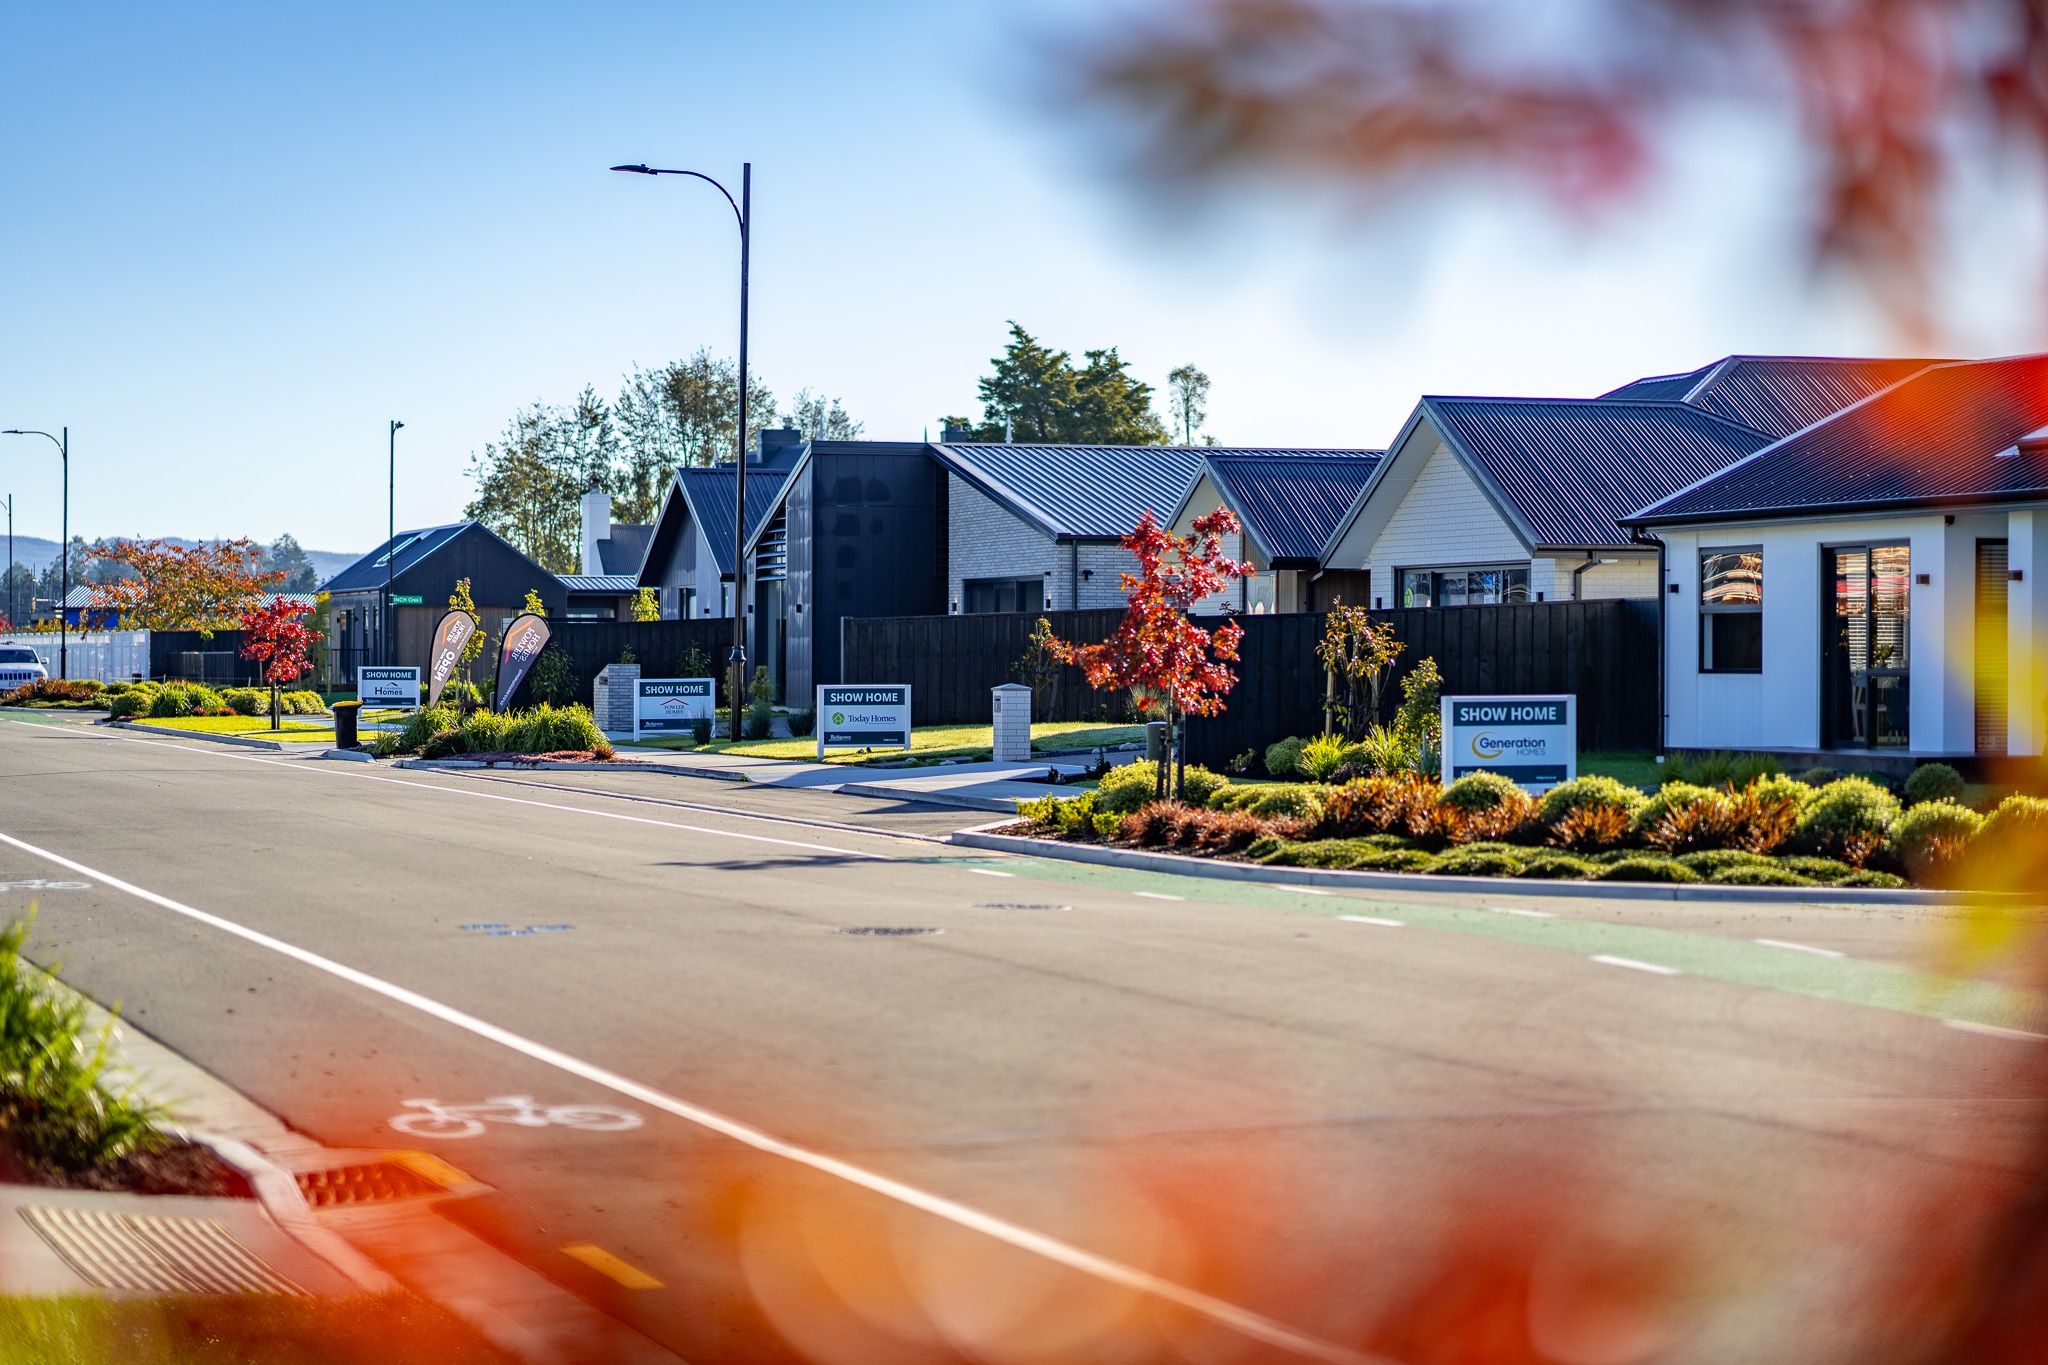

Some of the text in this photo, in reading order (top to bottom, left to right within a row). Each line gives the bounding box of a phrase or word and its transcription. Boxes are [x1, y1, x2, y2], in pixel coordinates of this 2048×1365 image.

[366, 671, 412, 679] SHOW HOME
[374, 686, 403, 696] Homes
[645, 685, 704, 694] SHOW HOME
[830, 692, 898, 702] SHOW HOME
[1460, 706, 1557, 721] SHOW HOME
[847, 714, 897, 724] Today Homes
[1480, 737, 1546, 748] Generation
[1516, 748, 1546, 756] HOMES
